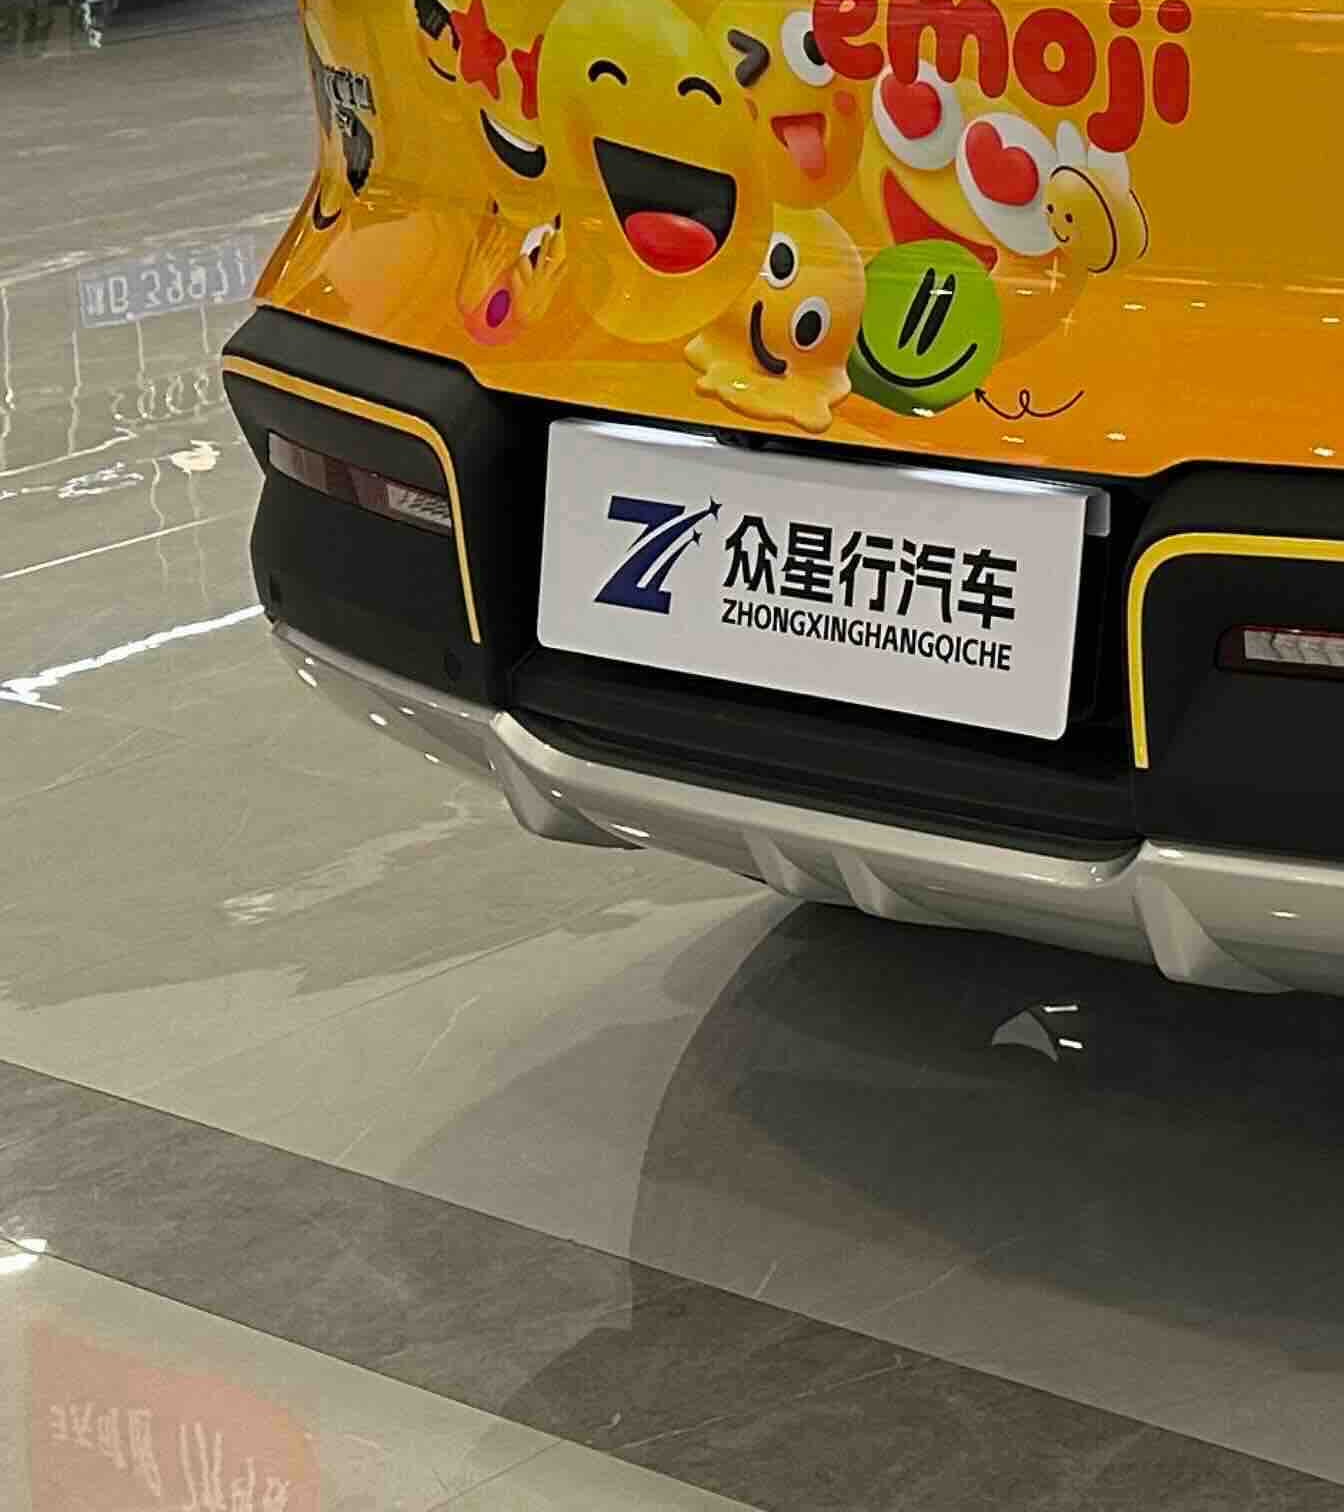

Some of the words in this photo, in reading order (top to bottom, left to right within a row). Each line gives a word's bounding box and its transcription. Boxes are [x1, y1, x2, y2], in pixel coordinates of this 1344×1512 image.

[722, 514, 1018, 629] 众星行汽车
[721, 598, 1013, 671] ZHONGXINGHANGQICHE
